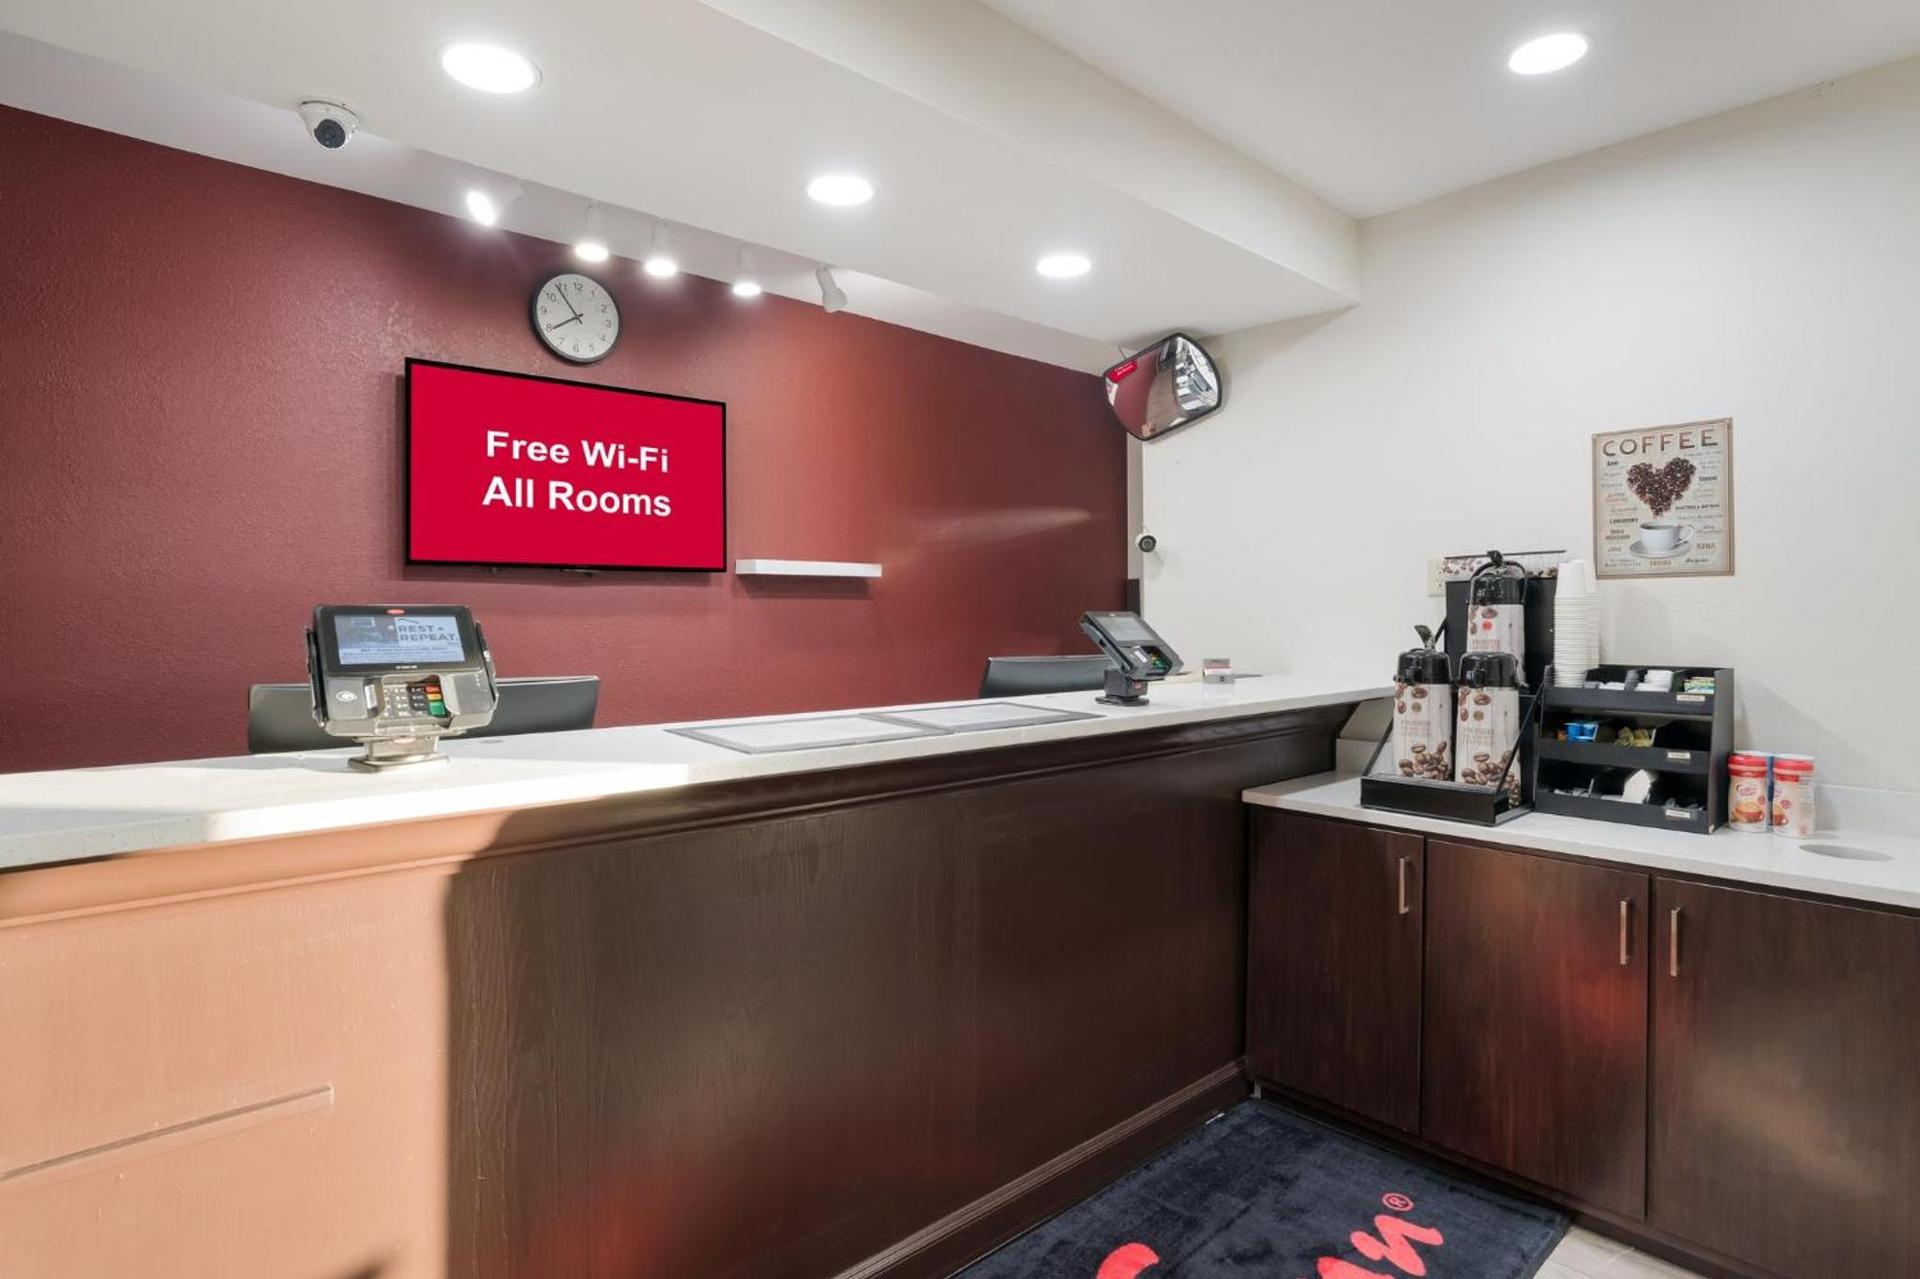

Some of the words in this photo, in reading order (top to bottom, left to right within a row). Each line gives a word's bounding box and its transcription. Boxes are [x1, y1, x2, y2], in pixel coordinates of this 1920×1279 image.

[574, 282, 584, 292] 12
[546, 292, 556, 302] 10
[486, 430, 570, 464] Free
[581, 440, 669, 473] Wi-Fi
[1602, 428, 1719, 457] COFFEE
[482, 475, 534, 509] All
[548, 480, 672, 517] Rooms
[398, 625, 434, 633] REST
